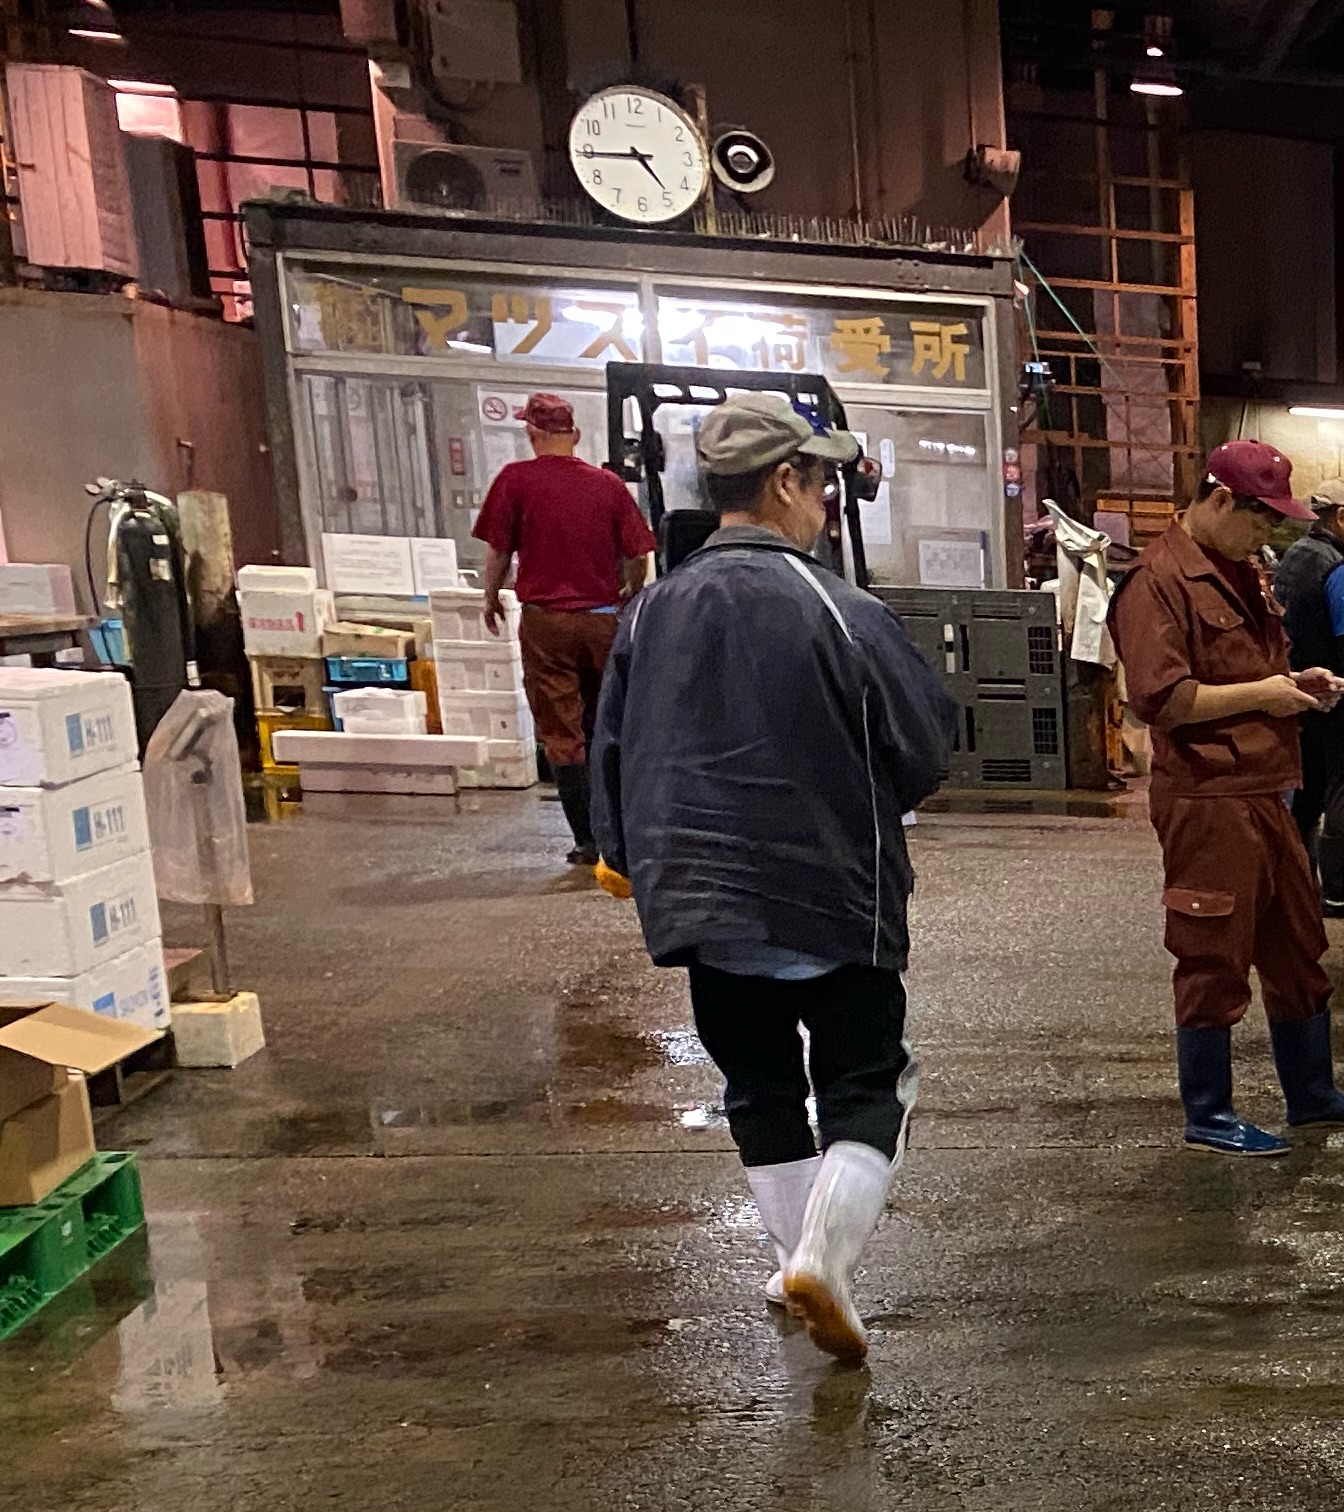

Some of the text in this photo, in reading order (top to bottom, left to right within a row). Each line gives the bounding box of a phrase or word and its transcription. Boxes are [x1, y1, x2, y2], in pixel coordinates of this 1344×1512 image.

[626, 97, 643, 115] 12
[586, 119, 600, 136] 10
[674, 126, 684, 142] 2
[682, 151, 693, 167] 3
[592, 169, 603, 185] 8
[680, 175, 690, 191] 4
[612, 187, 623, 204] 7
[662, 191, 673, 208] 5
[637, 196, 648, 212] 6
